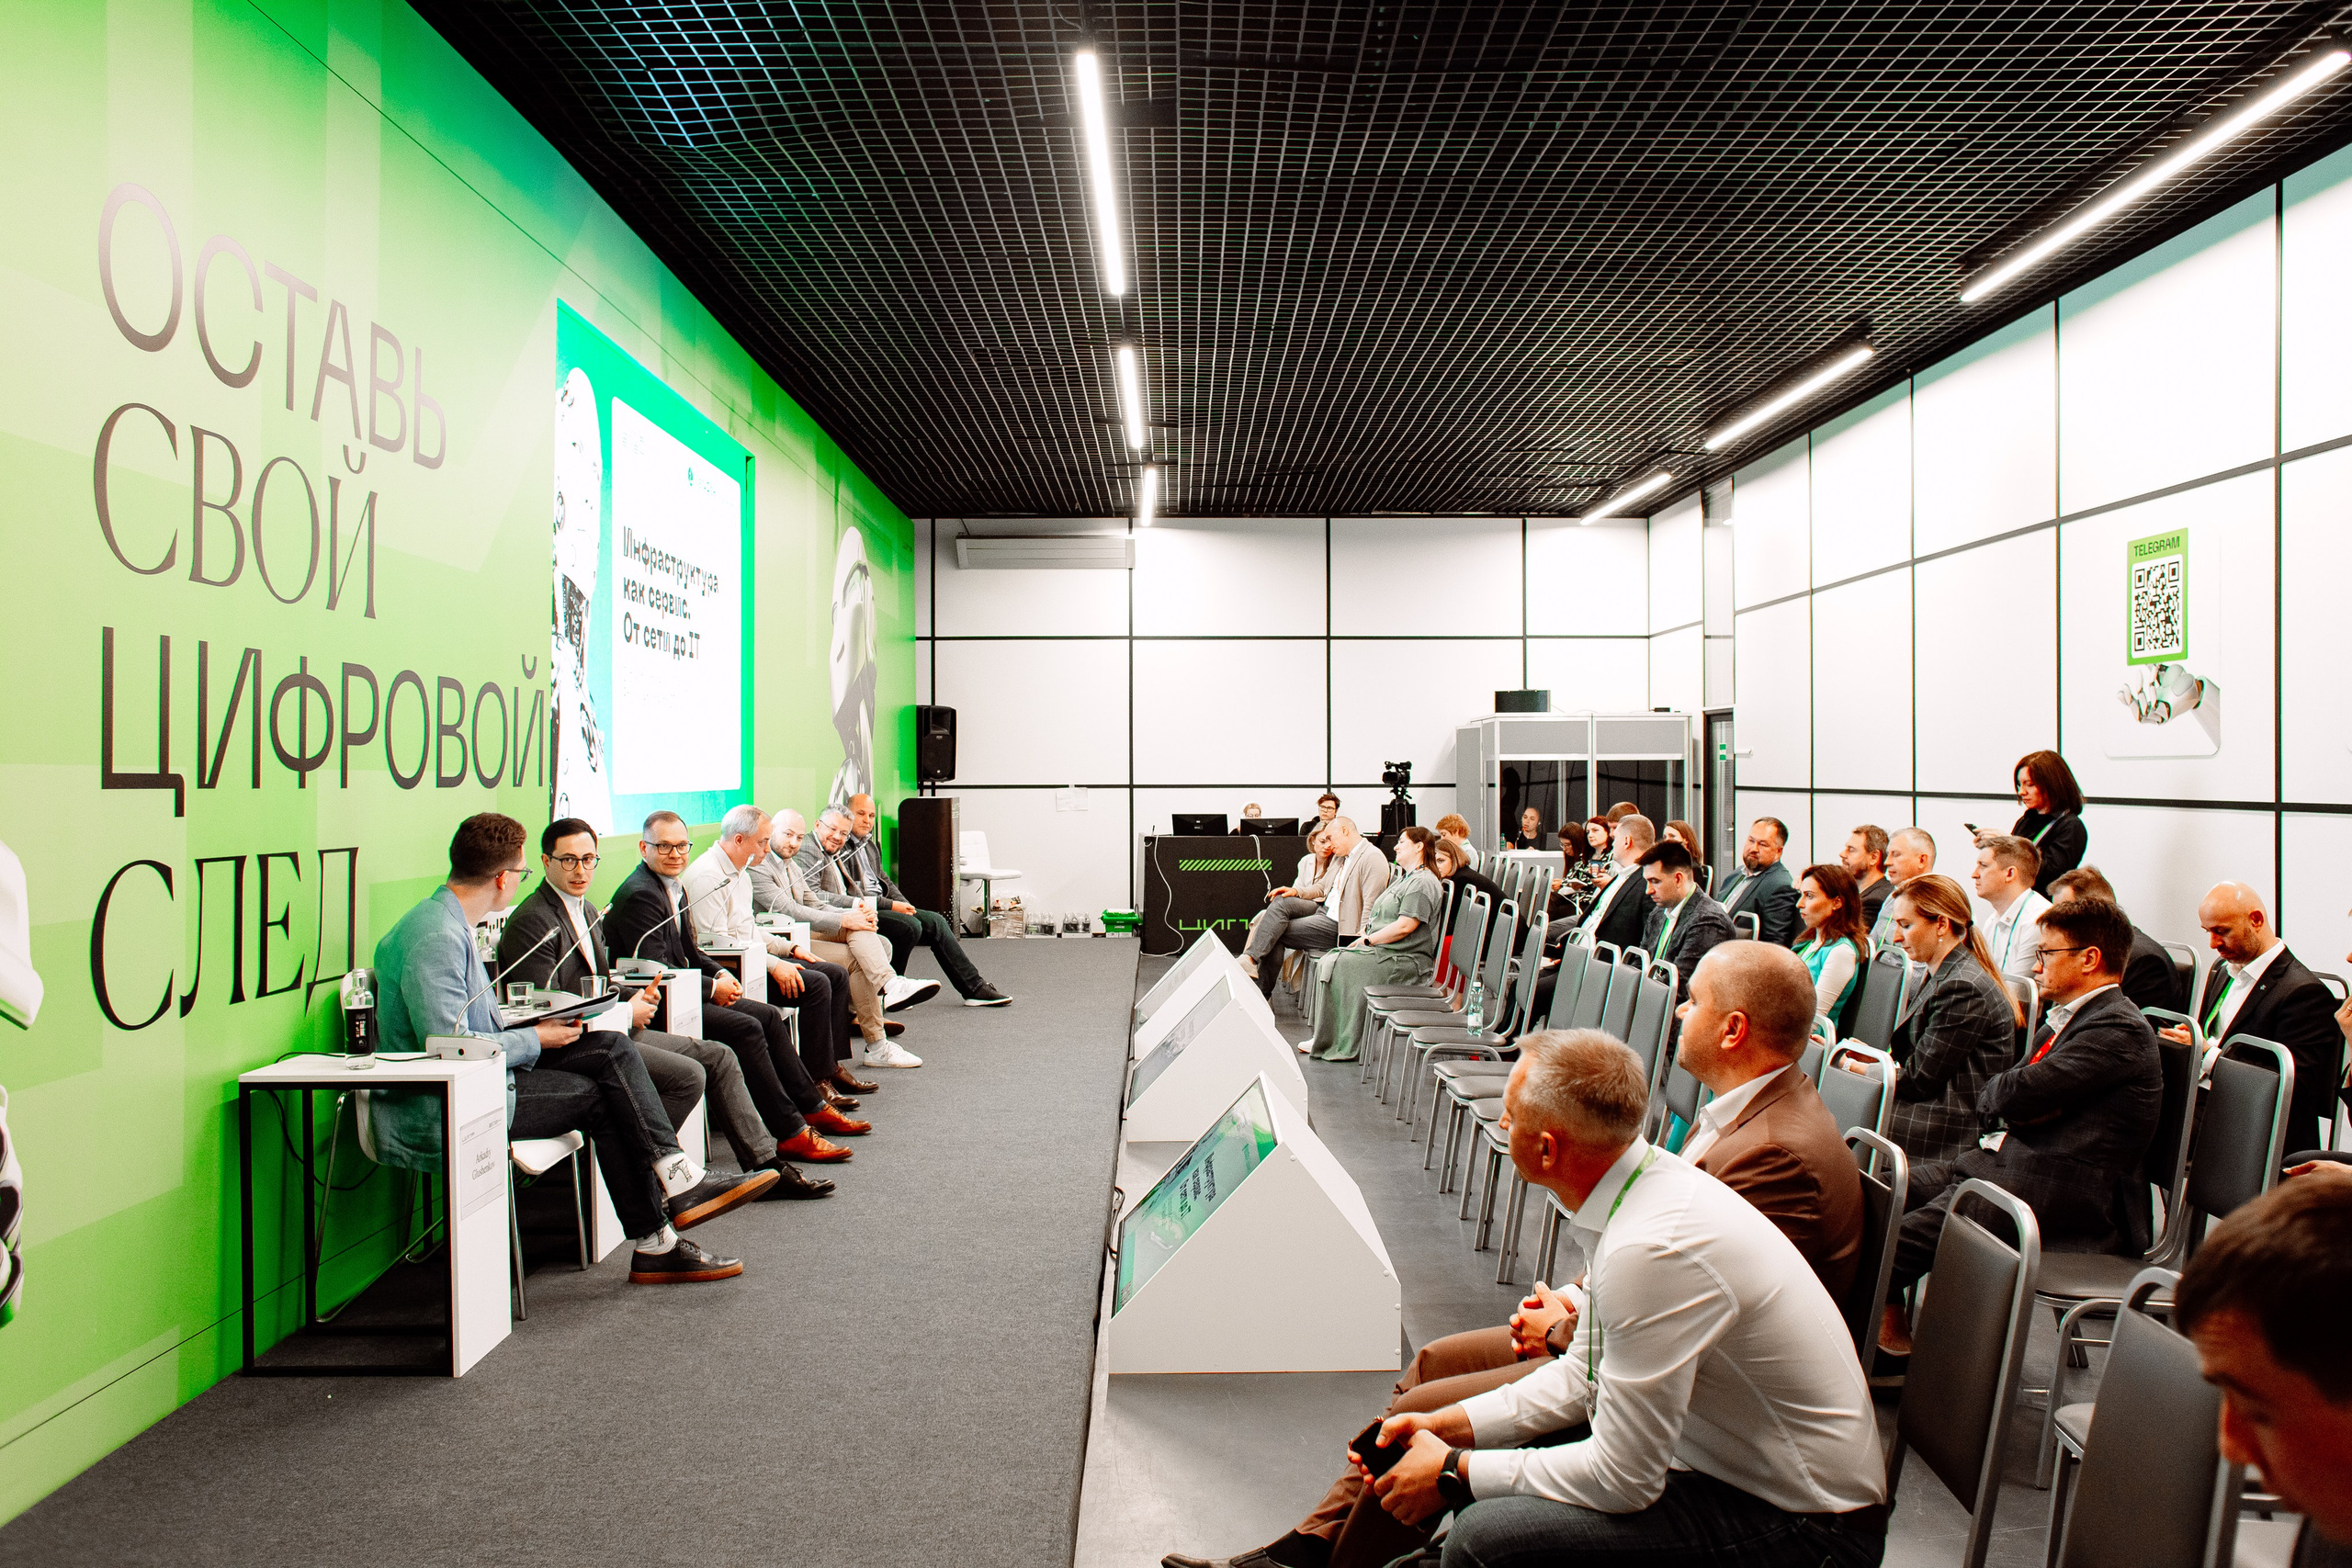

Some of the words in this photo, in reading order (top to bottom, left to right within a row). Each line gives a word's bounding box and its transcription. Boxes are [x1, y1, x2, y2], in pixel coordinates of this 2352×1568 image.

[97, 182, 447, 470] ОСТАВЬ
[93, 402, 379, 620] СВОЙ
[623, 525, 719, 598] Инфраструктура
[2133, 536, 2180, 558] TELEGRAM
[623, 577, 645, 605] как
[649, 586, 691, 620] сервис.
[623, 612, 640, 645] От
[643, 626, 671, 652] сети
[673, 634, 686, 660] до
[689, 631, 701, 660] IT
[101, 626, 545, 818] ЦИФРОВОЙ
[89, 846, 359, 1031] СЛЕД
